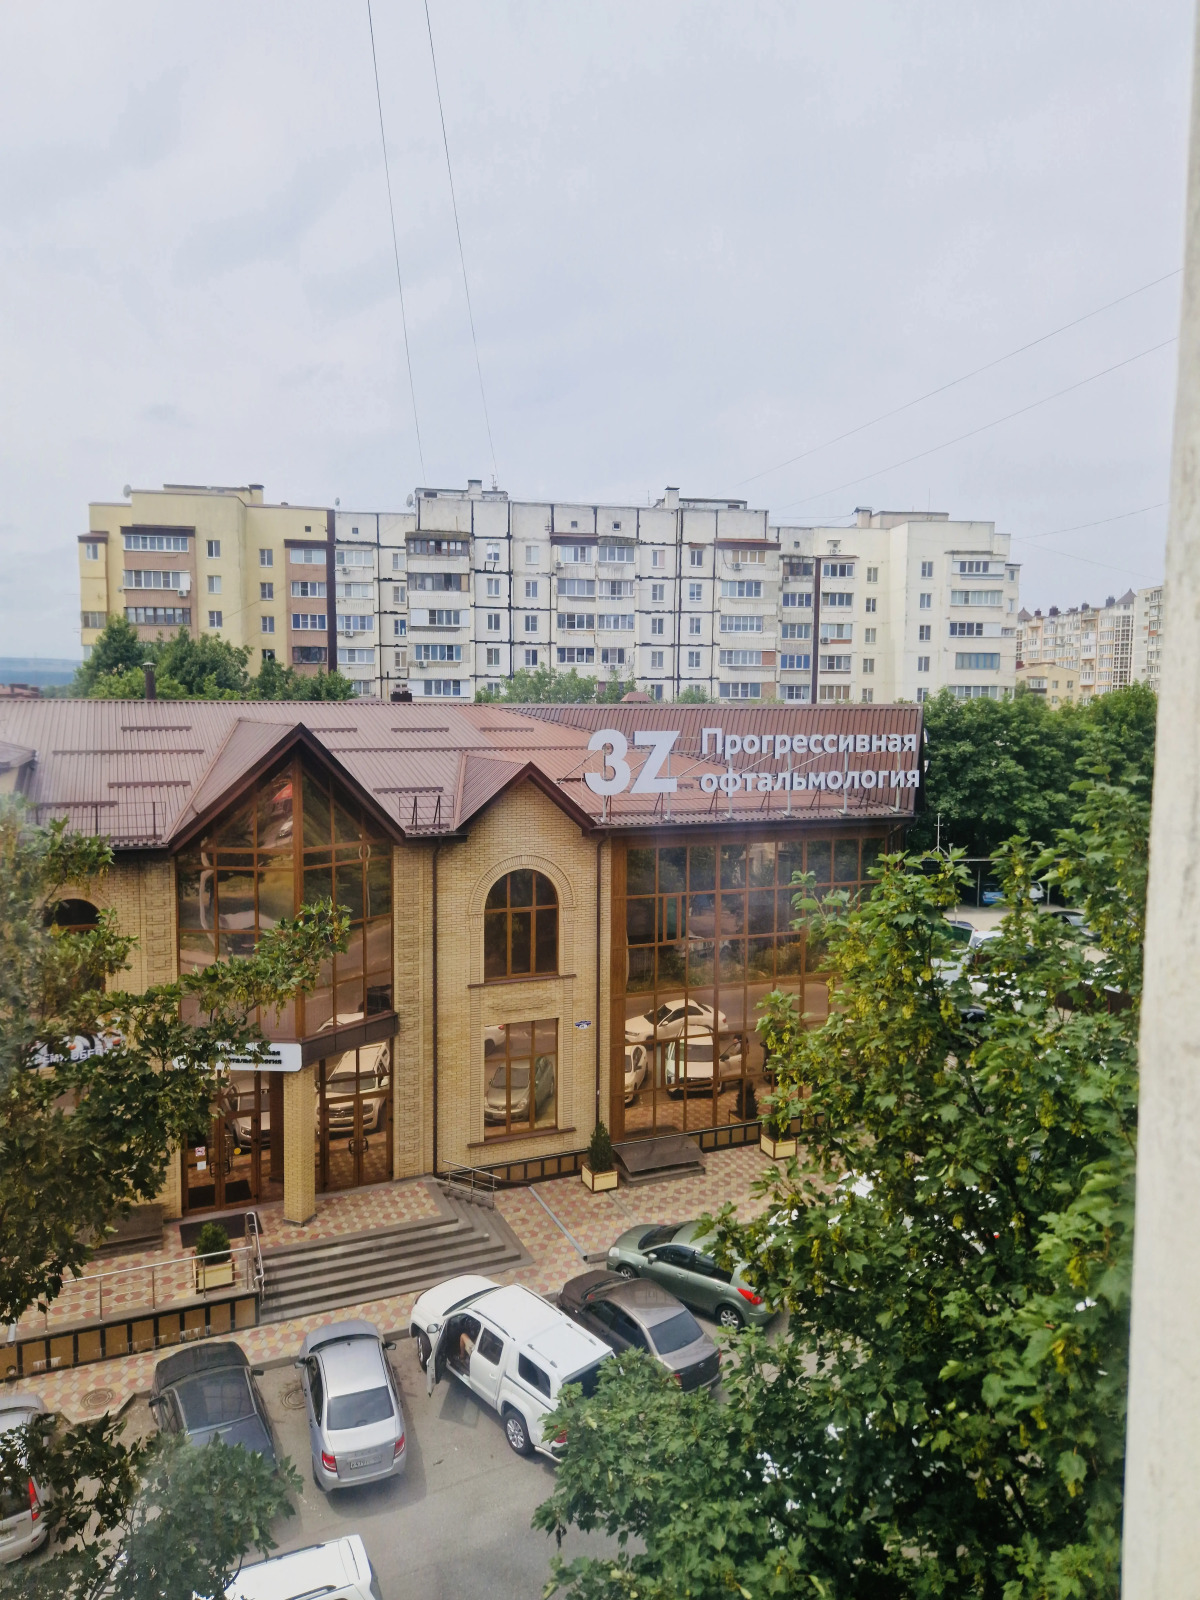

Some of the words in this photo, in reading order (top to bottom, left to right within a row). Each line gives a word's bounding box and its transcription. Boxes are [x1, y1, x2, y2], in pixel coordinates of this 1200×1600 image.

[701, 727, 917, 760] Прогрессивная
[584, 728, 680, 796] 3Z
[700, 768, 920, 797] офтальмология
